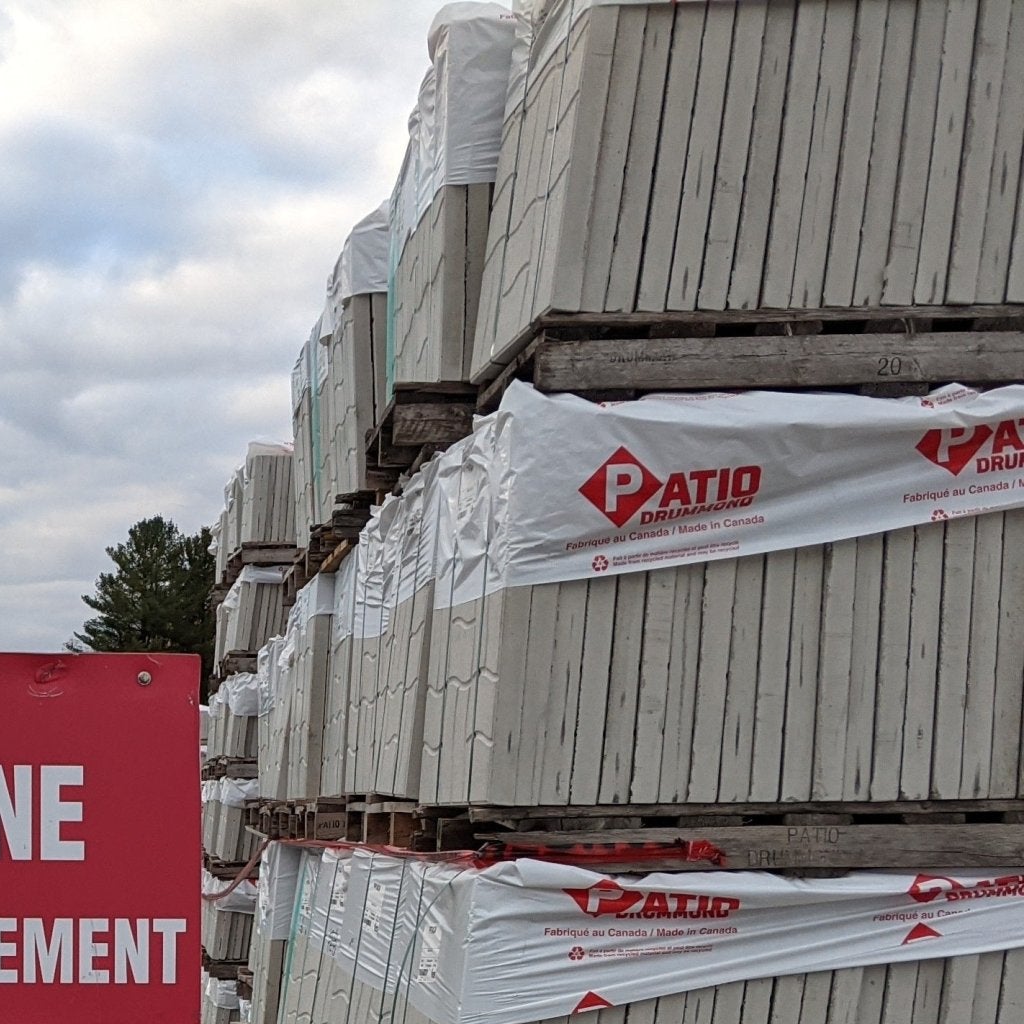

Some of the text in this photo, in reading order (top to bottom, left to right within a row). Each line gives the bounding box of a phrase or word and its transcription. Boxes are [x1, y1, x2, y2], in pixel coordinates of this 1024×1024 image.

[877, 356, 902, 376] 20
[604, 462, 762, 513] PATIO
[902, 487, 949, 503] Fabriqué
[952, 488, 966, 497] au
[968, 481, 1009, 495] Canada
[639, 496, 754, 526] DRUMMOND
[613, 534, 626, 543] au
[629, 524, 670, 542] Canada
[678, 522, 708, 534] Made
[710, 520, 721, 531] in
[723, 514, 765, 529] Canada
[786, 826, 840, 844] PATIO
[921, 911, 934, 919] au
[544, 927, 589, 939] Fabriqué
[592, 929, 605, 938] au
[608, 927, 647, 938] Canada
[656, 927, 684, 938] Made
[687, 926, 697, 936] in
[699, 925, 738, 936] Canada
